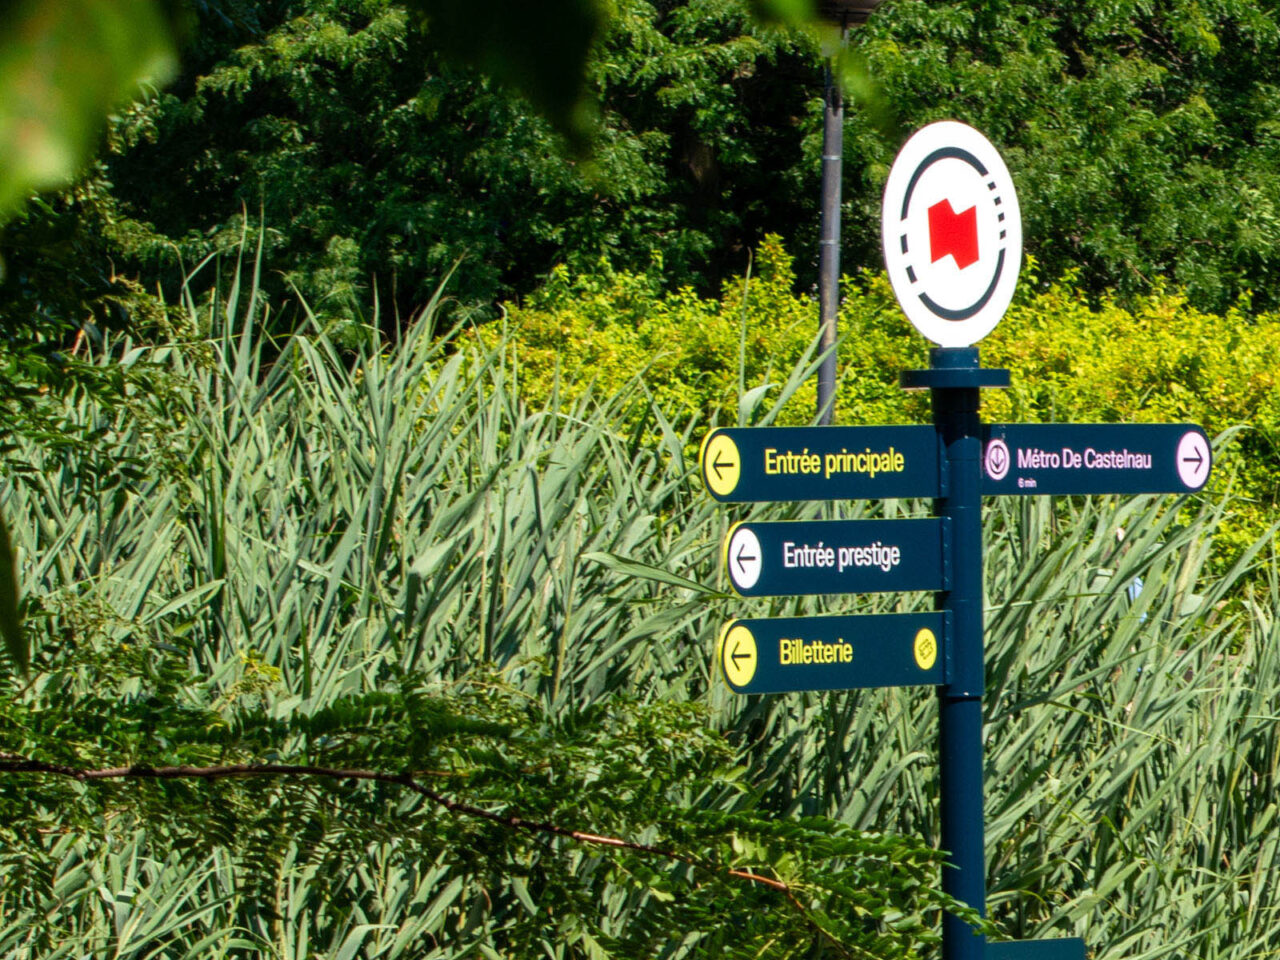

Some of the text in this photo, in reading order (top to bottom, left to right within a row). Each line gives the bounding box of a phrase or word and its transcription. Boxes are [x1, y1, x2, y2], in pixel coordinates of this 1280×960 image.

[764, 446, 905, 479] Entrée principale
[1017, 448, 1152, 469] Métro De Castelnau
[1025, 478, 1037, 488] min
[783, 541, 901, 573] Entrée prestige
[779, 638, 854, 666] Billetterie
